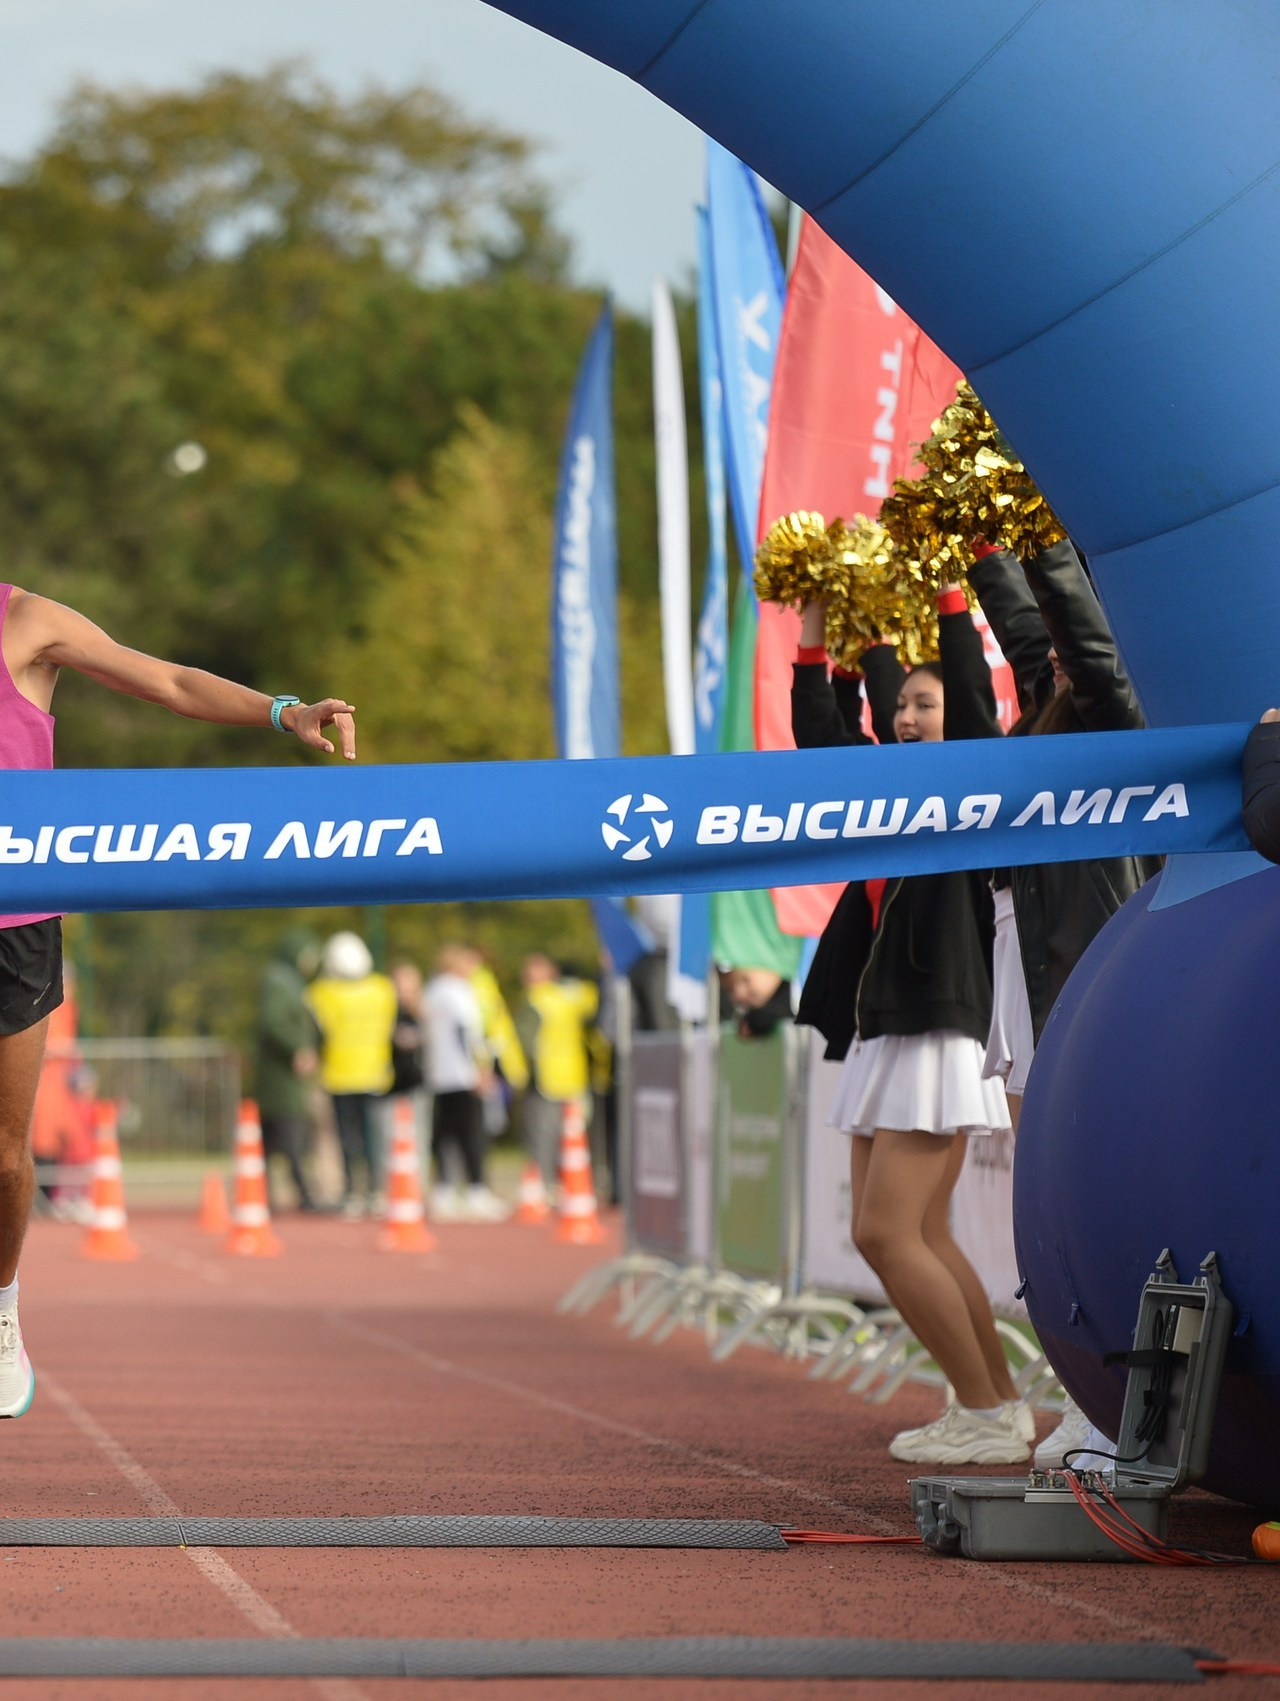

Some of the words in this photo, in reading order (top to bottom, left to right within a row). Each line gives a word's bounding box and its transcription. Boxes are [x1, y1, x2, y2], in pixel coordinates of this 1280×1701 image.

[263, 817, 444, 861] ЛИГА
[695, 795, 1002, 845] ВЫСШАЯ
[1010, 782, 1190, 828] ЛИГА
